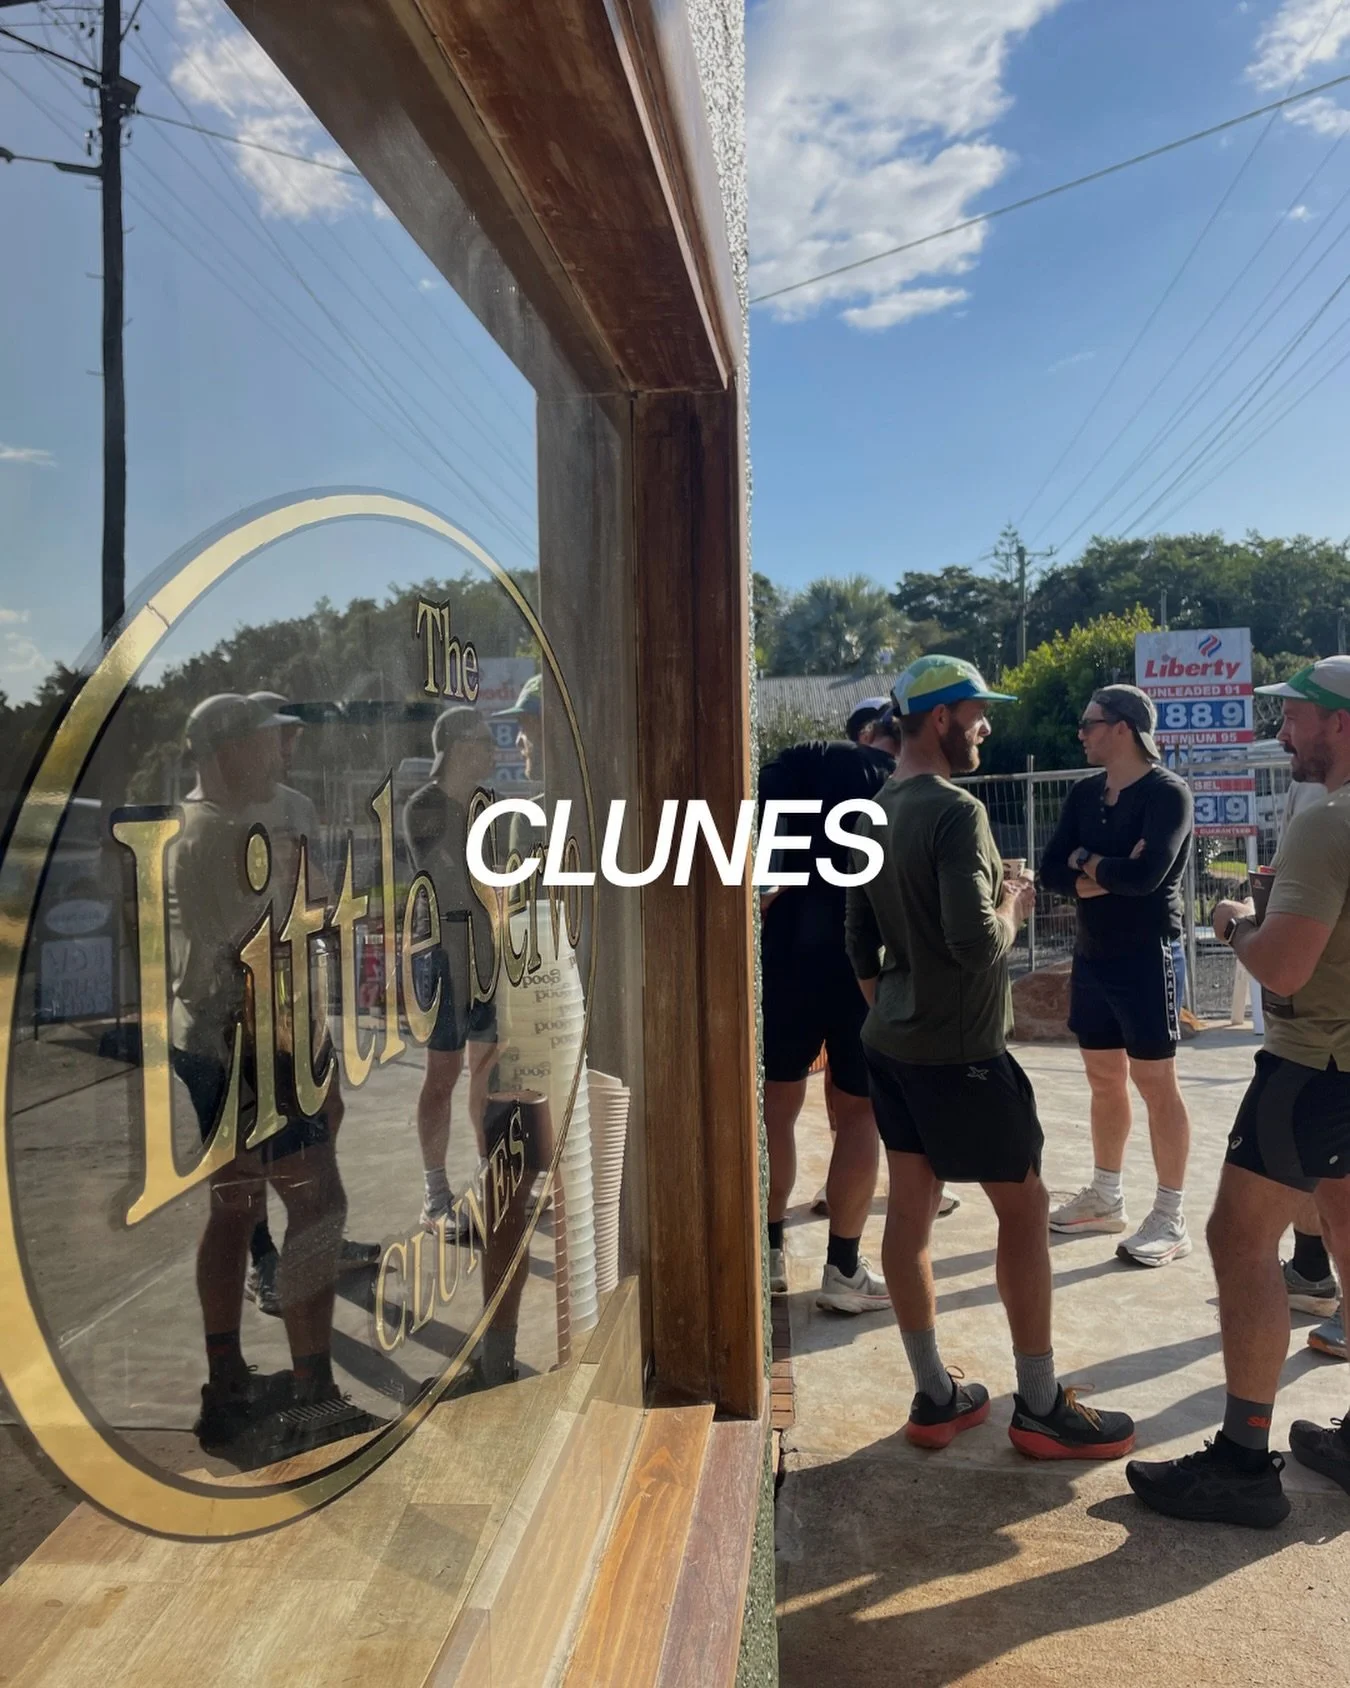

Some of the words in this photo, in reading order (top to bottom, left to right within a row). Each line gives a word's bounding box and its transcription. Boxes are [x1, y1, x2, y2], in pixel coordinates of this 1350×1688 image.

[415, 596, 479, 703] The
[1145, 656, 1241, 679] Liberty
[1147, 686, 1221, 697] UNLEADED
[1224, 685, 1240, 695] 91
[1164, 701, 1243, 728] 88.9
[1220, 732, 1238, 743] 95
[1194, 780, 1220, 791] SEL
[110, 769, 442, 1226] Little
[375, 1102, 526, 1351] CLUNES
